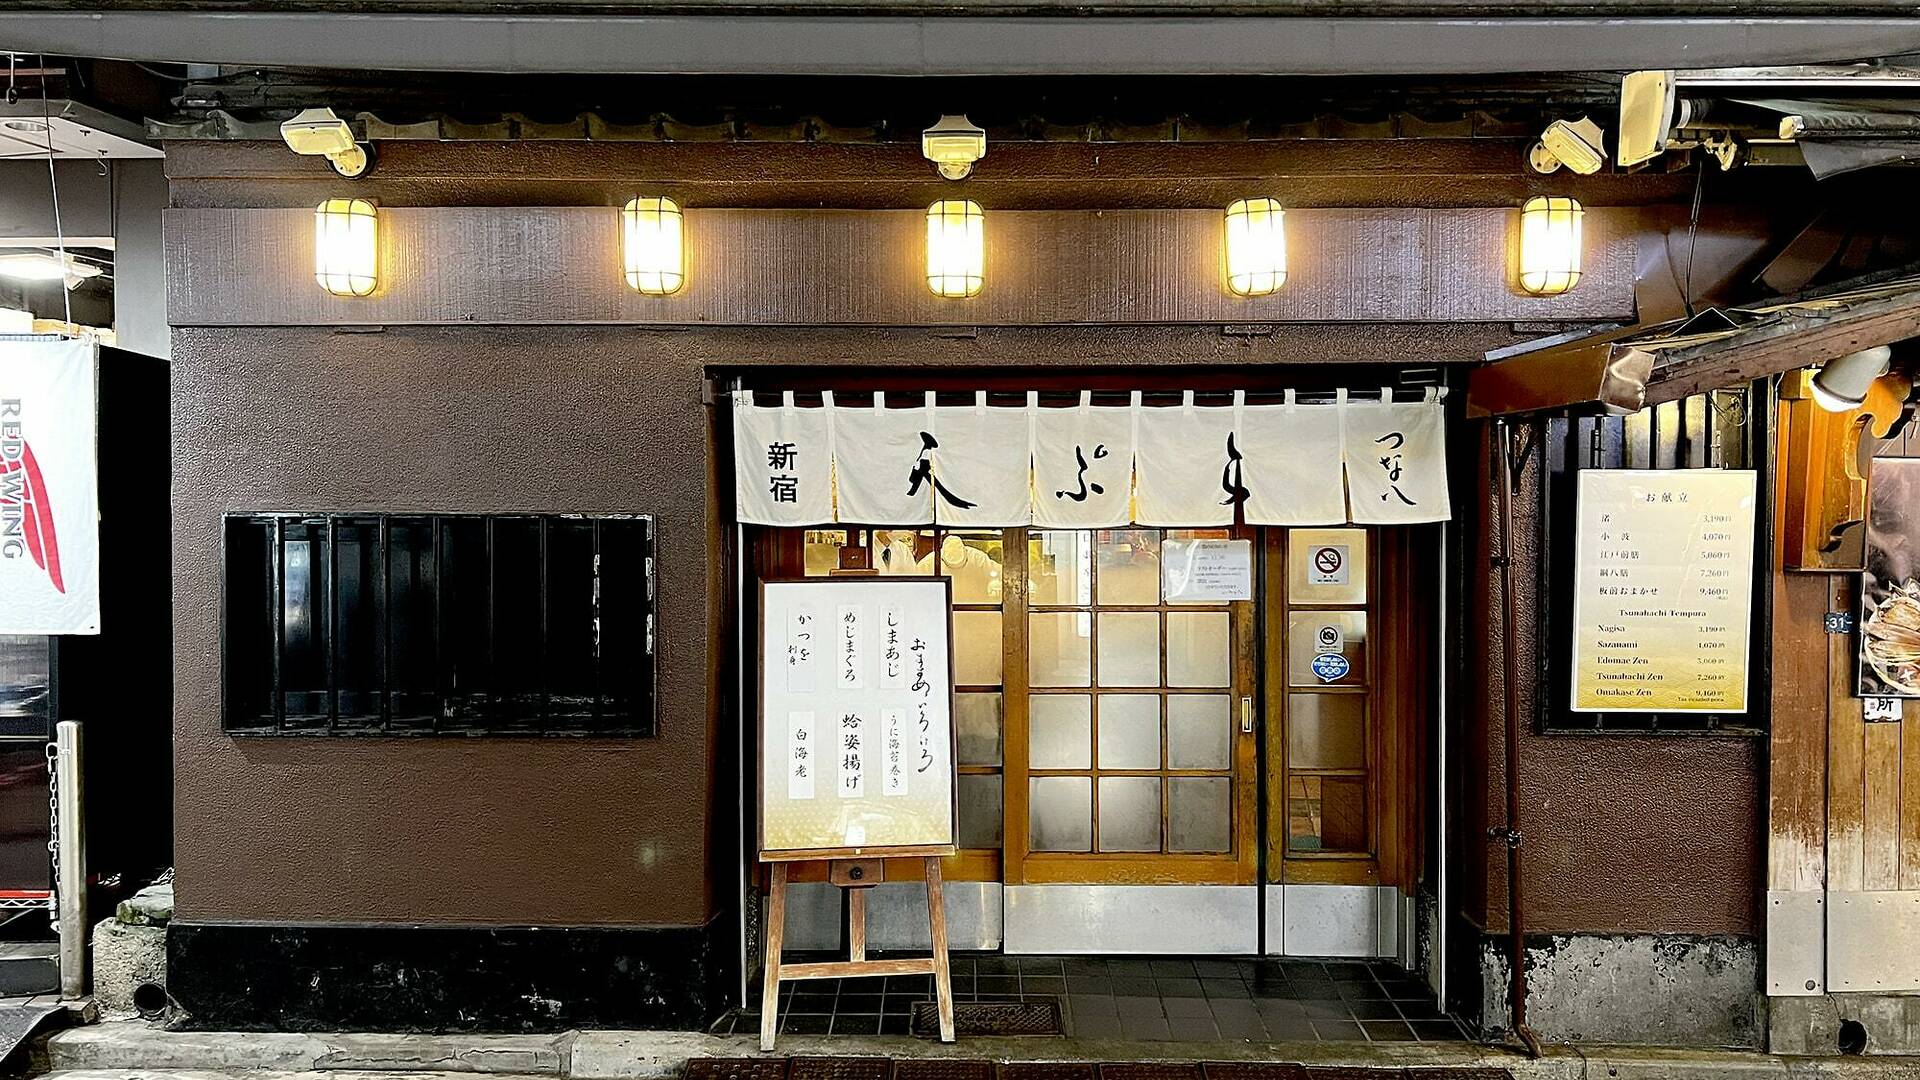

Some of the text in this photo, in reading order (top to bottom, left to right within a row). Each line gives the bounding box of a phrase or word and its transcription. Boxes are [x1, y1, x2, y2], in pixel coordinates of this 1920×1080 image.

[1, 398, 25, 559] RED WING
[767, 441, 799, 504] 新宿
[1373, 431, 1417, 507] つな八
[797, 614, 812, 661] かつを
[1598, 624, 1626, 634] Nagisa
[1620, 609, 1707, 619] Tsunahachi Tempura
[843, 612, 857, 682] めじまぐろ
[885, 612, 900, 678] しまあじ
[1597, 640, 1639, 649] Sazanami
[1632, 656, 1649, 665] Zen
[1595, 688, 1652, 697] Omakase Zen
[1647, 672, 1664, 681] Zen
[794, 728, 809, 778] 白海老
[842, 713, 863, 790] 蛤姿揚げ
